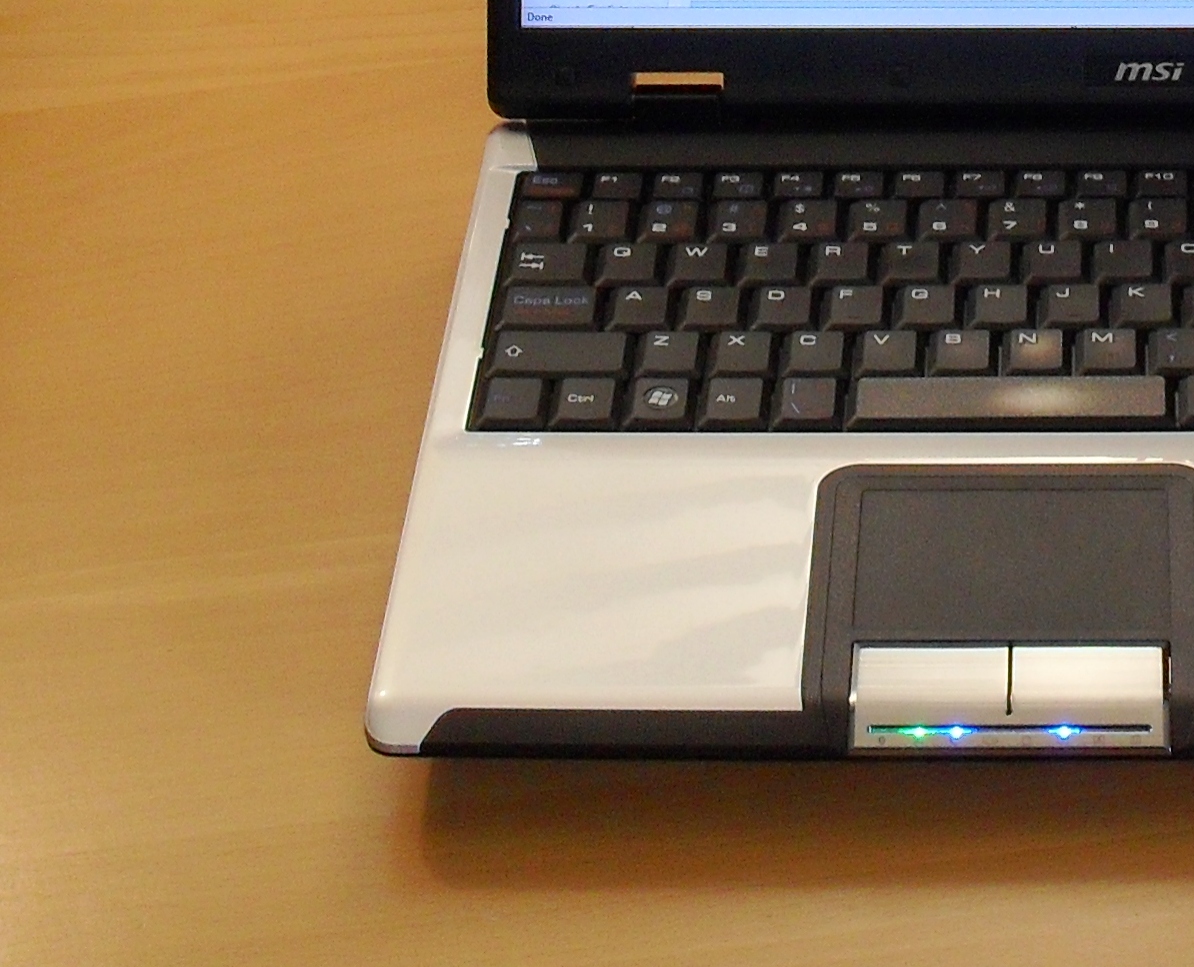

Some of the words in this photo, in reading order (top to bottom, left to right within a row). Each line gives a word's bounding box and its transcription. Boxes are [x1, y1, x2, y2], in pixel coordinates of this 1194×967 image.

[527, 11, 554, 22] Done
[1114, 61, 1185, 82] msi
[613, 246, 632, 258] Q
[685, 246, 708, 257] W
[754, 245, 769, 257] E
[825, 245, 841, 257] R
[896, 244, 913, 256] T
[969, 244, 986, 255] Y
[1038, 243, 1055, 255] U
[625, 290, 643, 301] A
[696, 289, 712, 302] S
[767, 289, 785, 301] D
[839, 288, 853, 300] F
[911, 288, 929, 300] G
[983, 288, 1001, 299] H
[1055, 287, 1070, 298] J
[1127, 286, 1145, 298] K
[567, 393, 595, 403] Ctrl
